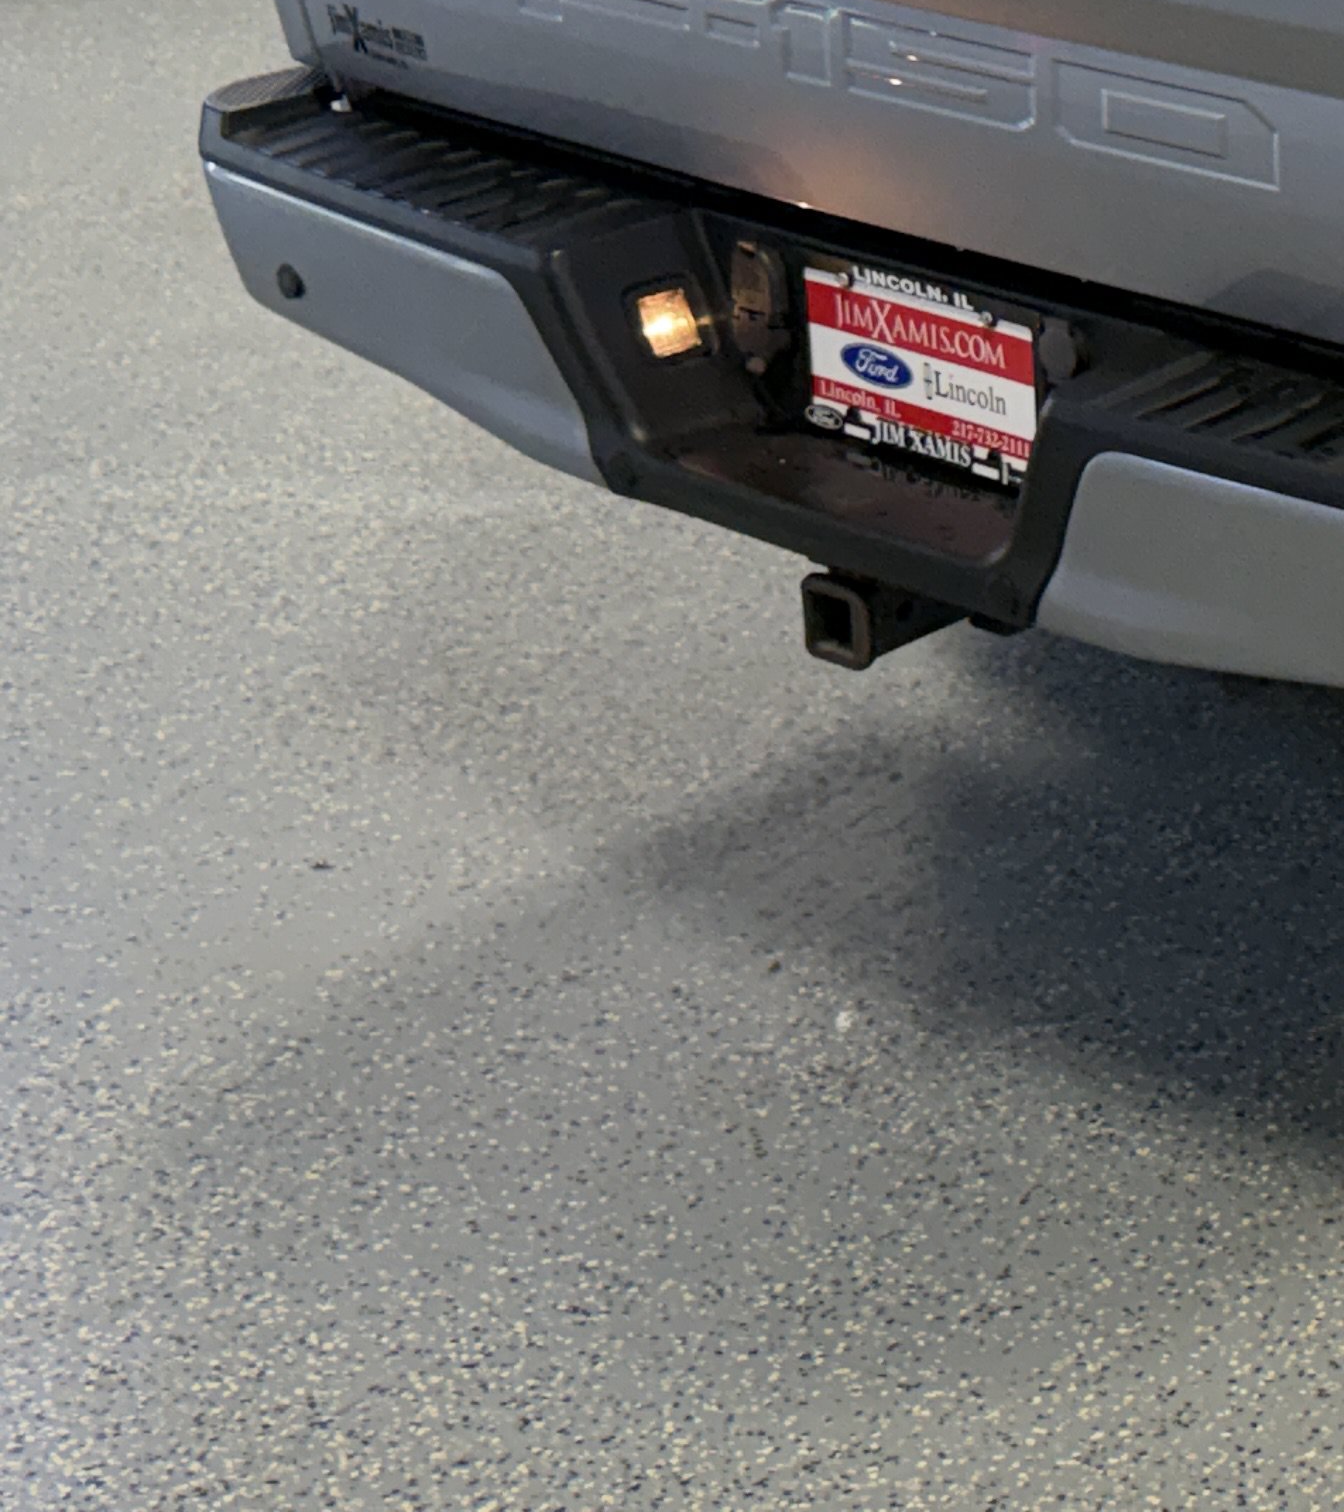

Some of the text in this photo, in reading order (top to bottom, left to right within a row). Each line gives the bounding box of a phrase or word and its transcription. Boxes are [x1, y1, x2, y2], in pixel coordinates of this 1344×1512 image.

[953, 291, 974, 311] IL
[835, 293, 1007, 369] JIMXAMIS.COM
[855, 348, 899, 382] Ford
[934, 371, 1007, 416] Lincoln
[870, 418, 972, 468] JIM XAMIS
